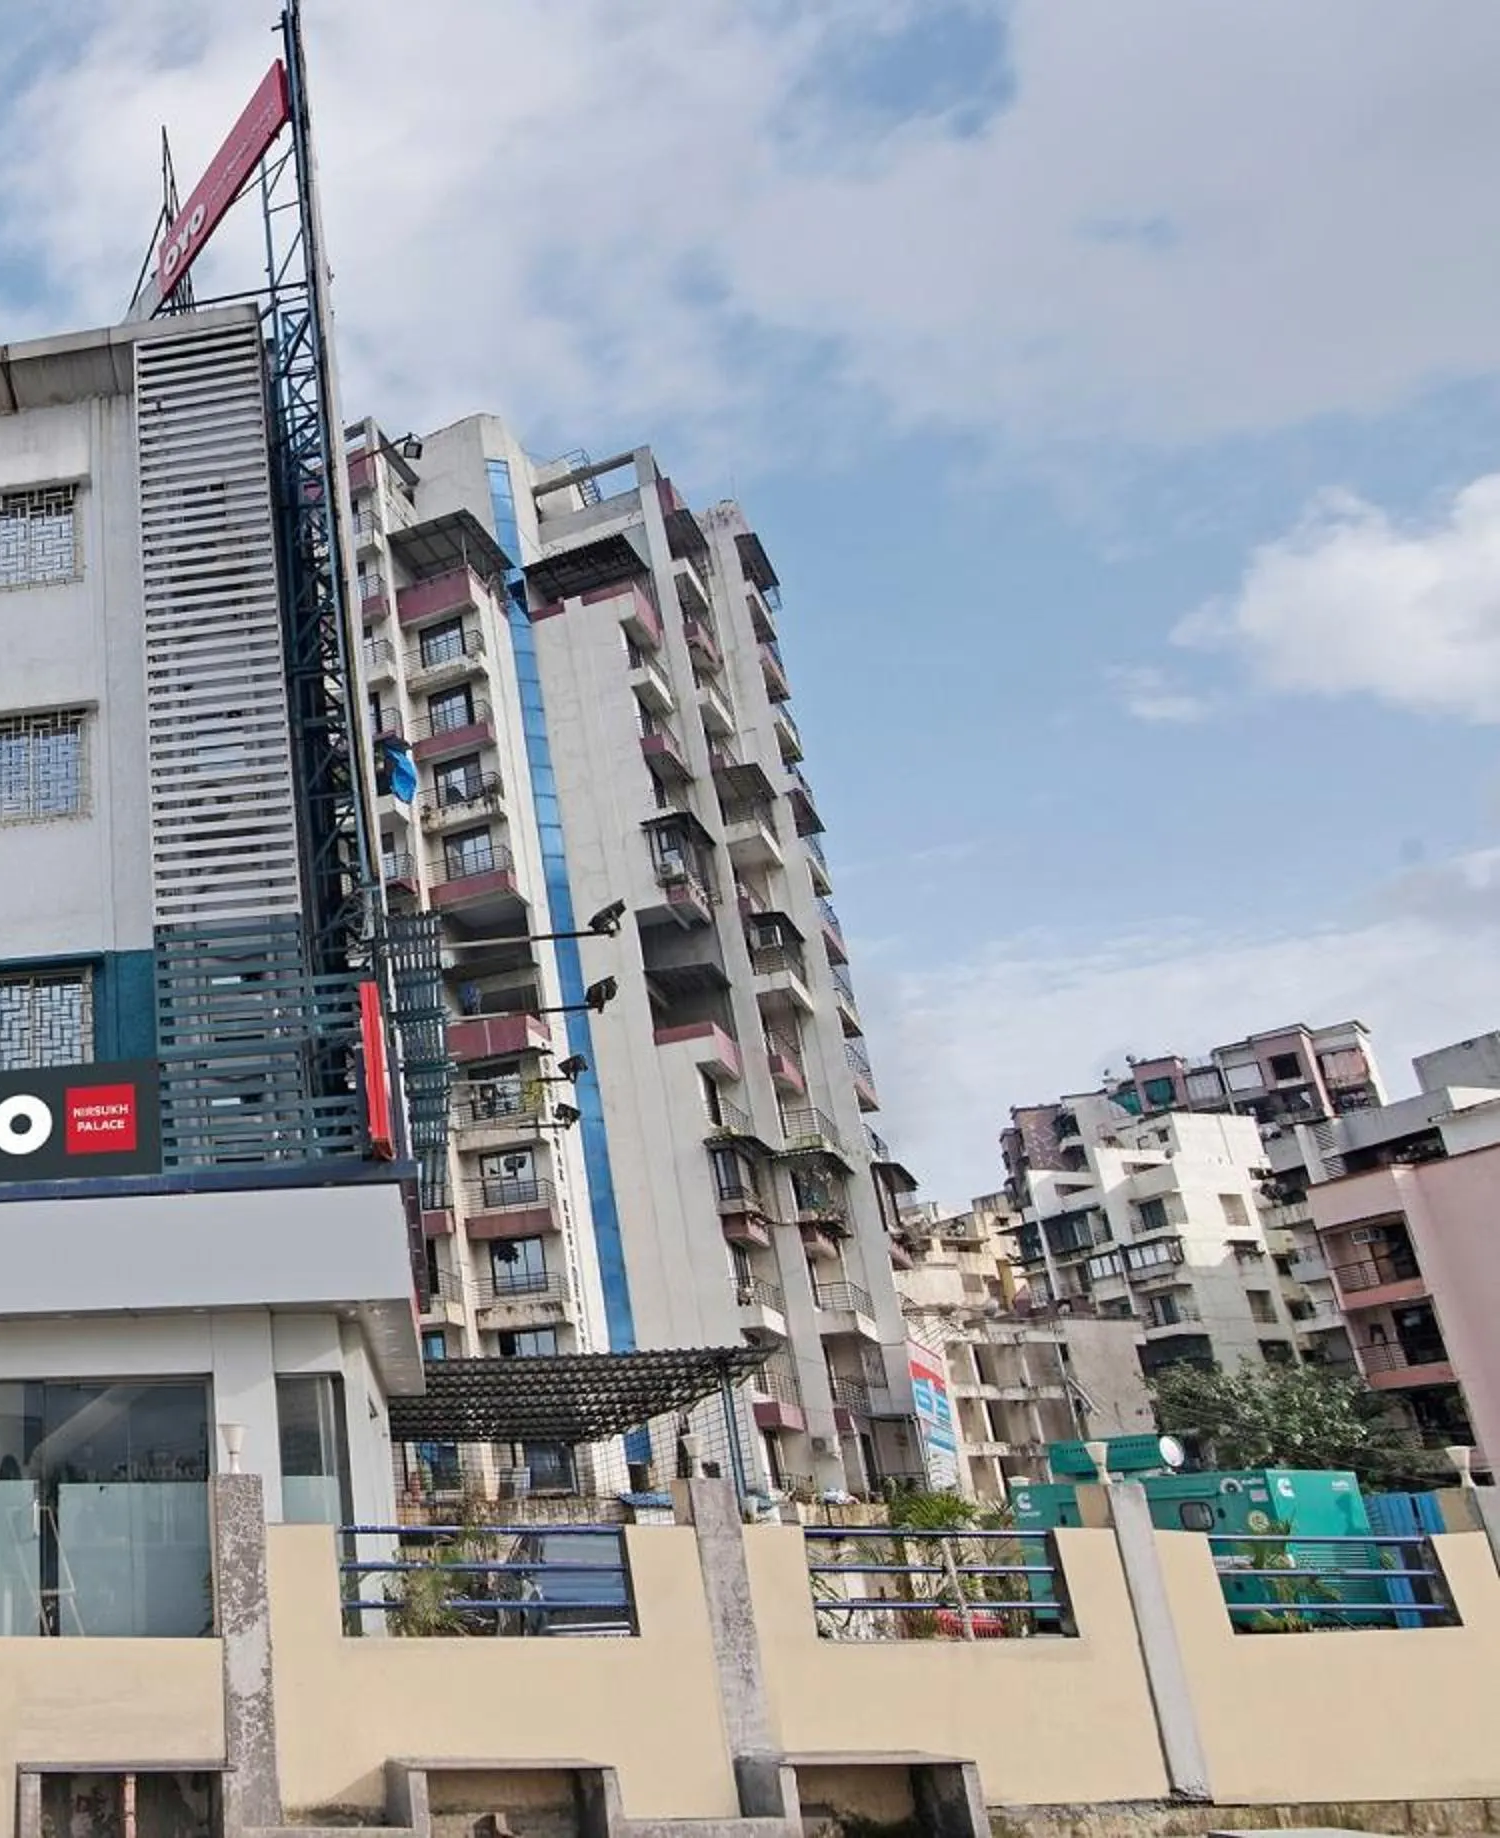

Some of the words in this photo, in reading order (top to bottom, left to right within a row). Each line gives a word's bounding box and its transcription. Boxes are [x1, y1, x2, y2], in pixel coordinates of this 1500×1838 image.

[164, 204, 206, 275] OYO
[73, 1103, 129, 1118] NIRSUKH
[77, 1119, 125, 1132] PALACE
